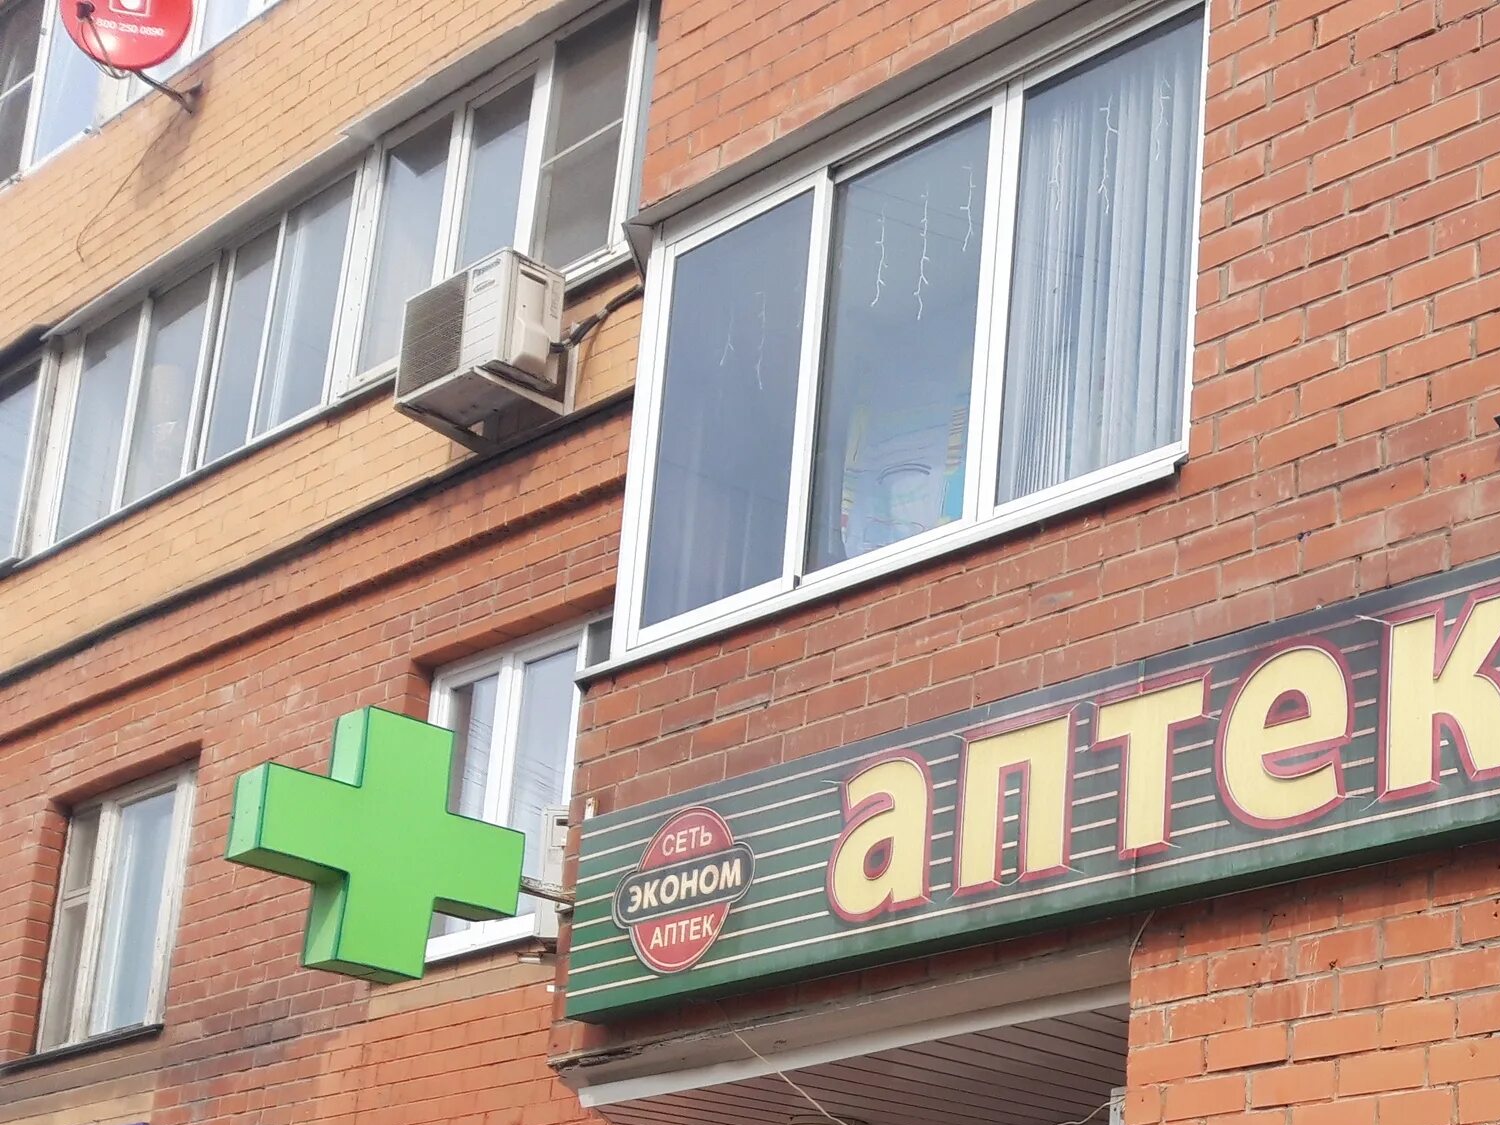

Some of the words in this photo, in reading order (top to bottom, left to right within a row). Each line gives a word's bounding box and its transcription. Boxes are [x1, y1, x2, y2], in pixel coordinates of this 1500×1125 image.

[661, 825, 713, 857] СЕТЬ
[626, 858, 742, 914] ЭКОНОМ
[649, 913, 715, 950] АПТЕК
